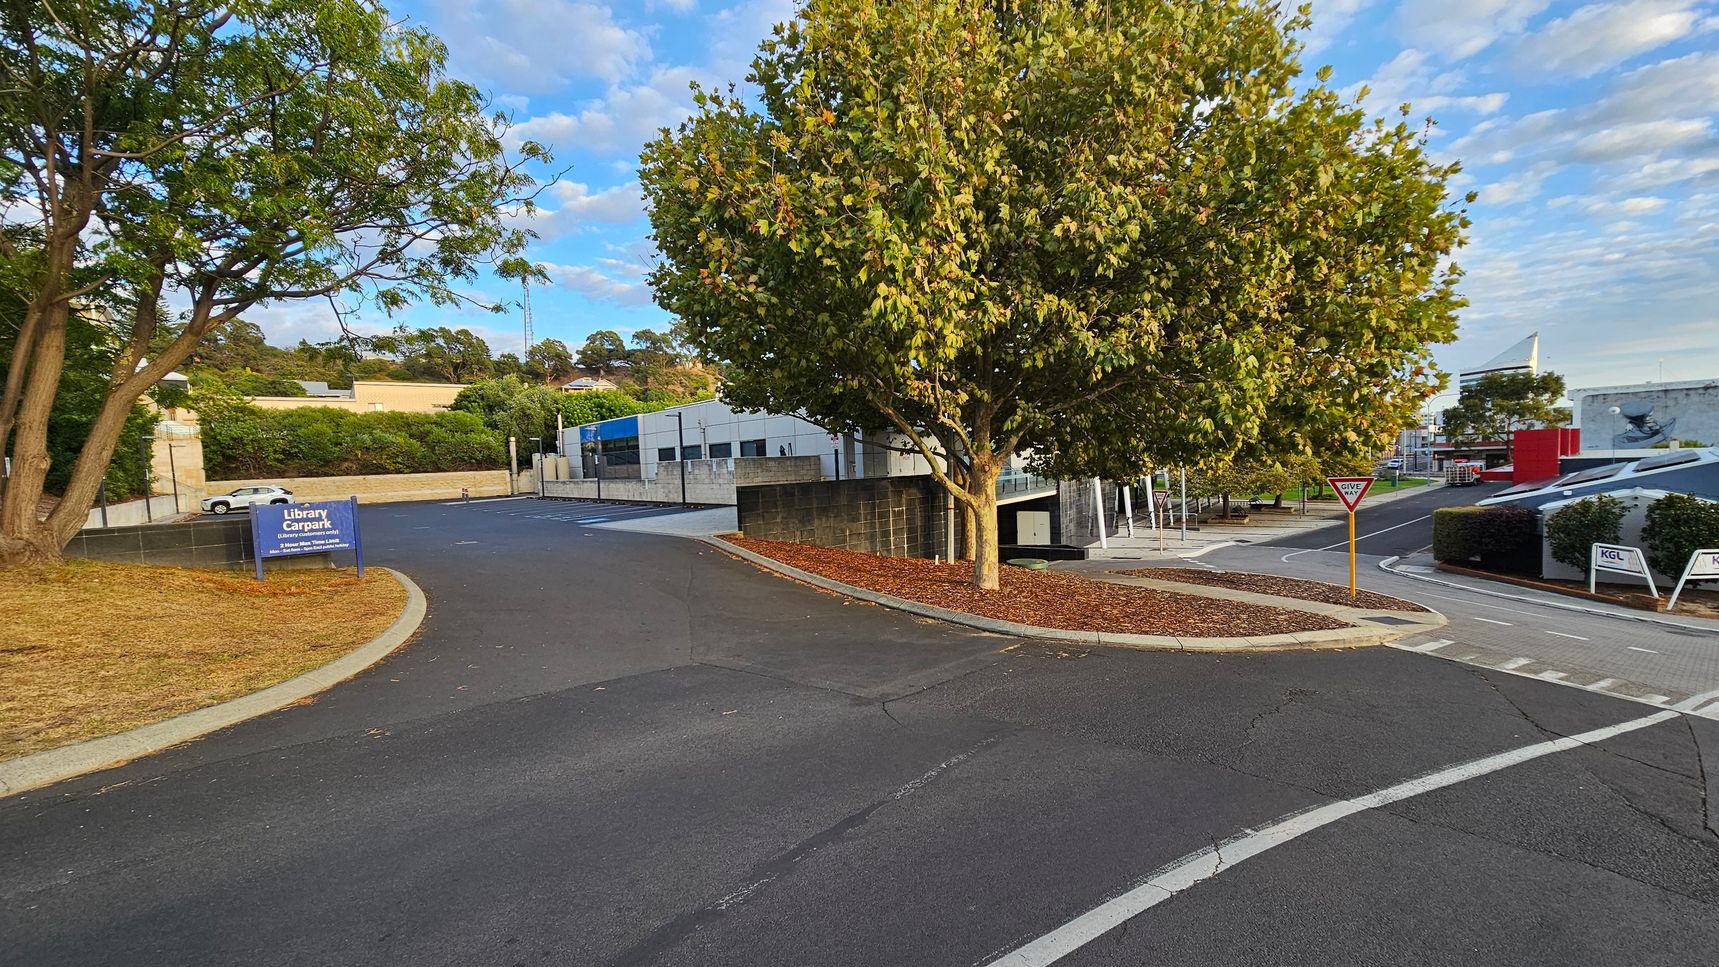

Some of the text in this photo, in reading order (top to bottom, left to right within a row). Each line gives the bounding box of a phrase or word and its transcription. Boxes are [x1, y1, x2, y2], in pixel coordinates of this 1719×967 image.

[284, 509, 327, 519] Library
[283, 519, 331, 531] Carpark
[1601, 549, 1624, 561] KGL
